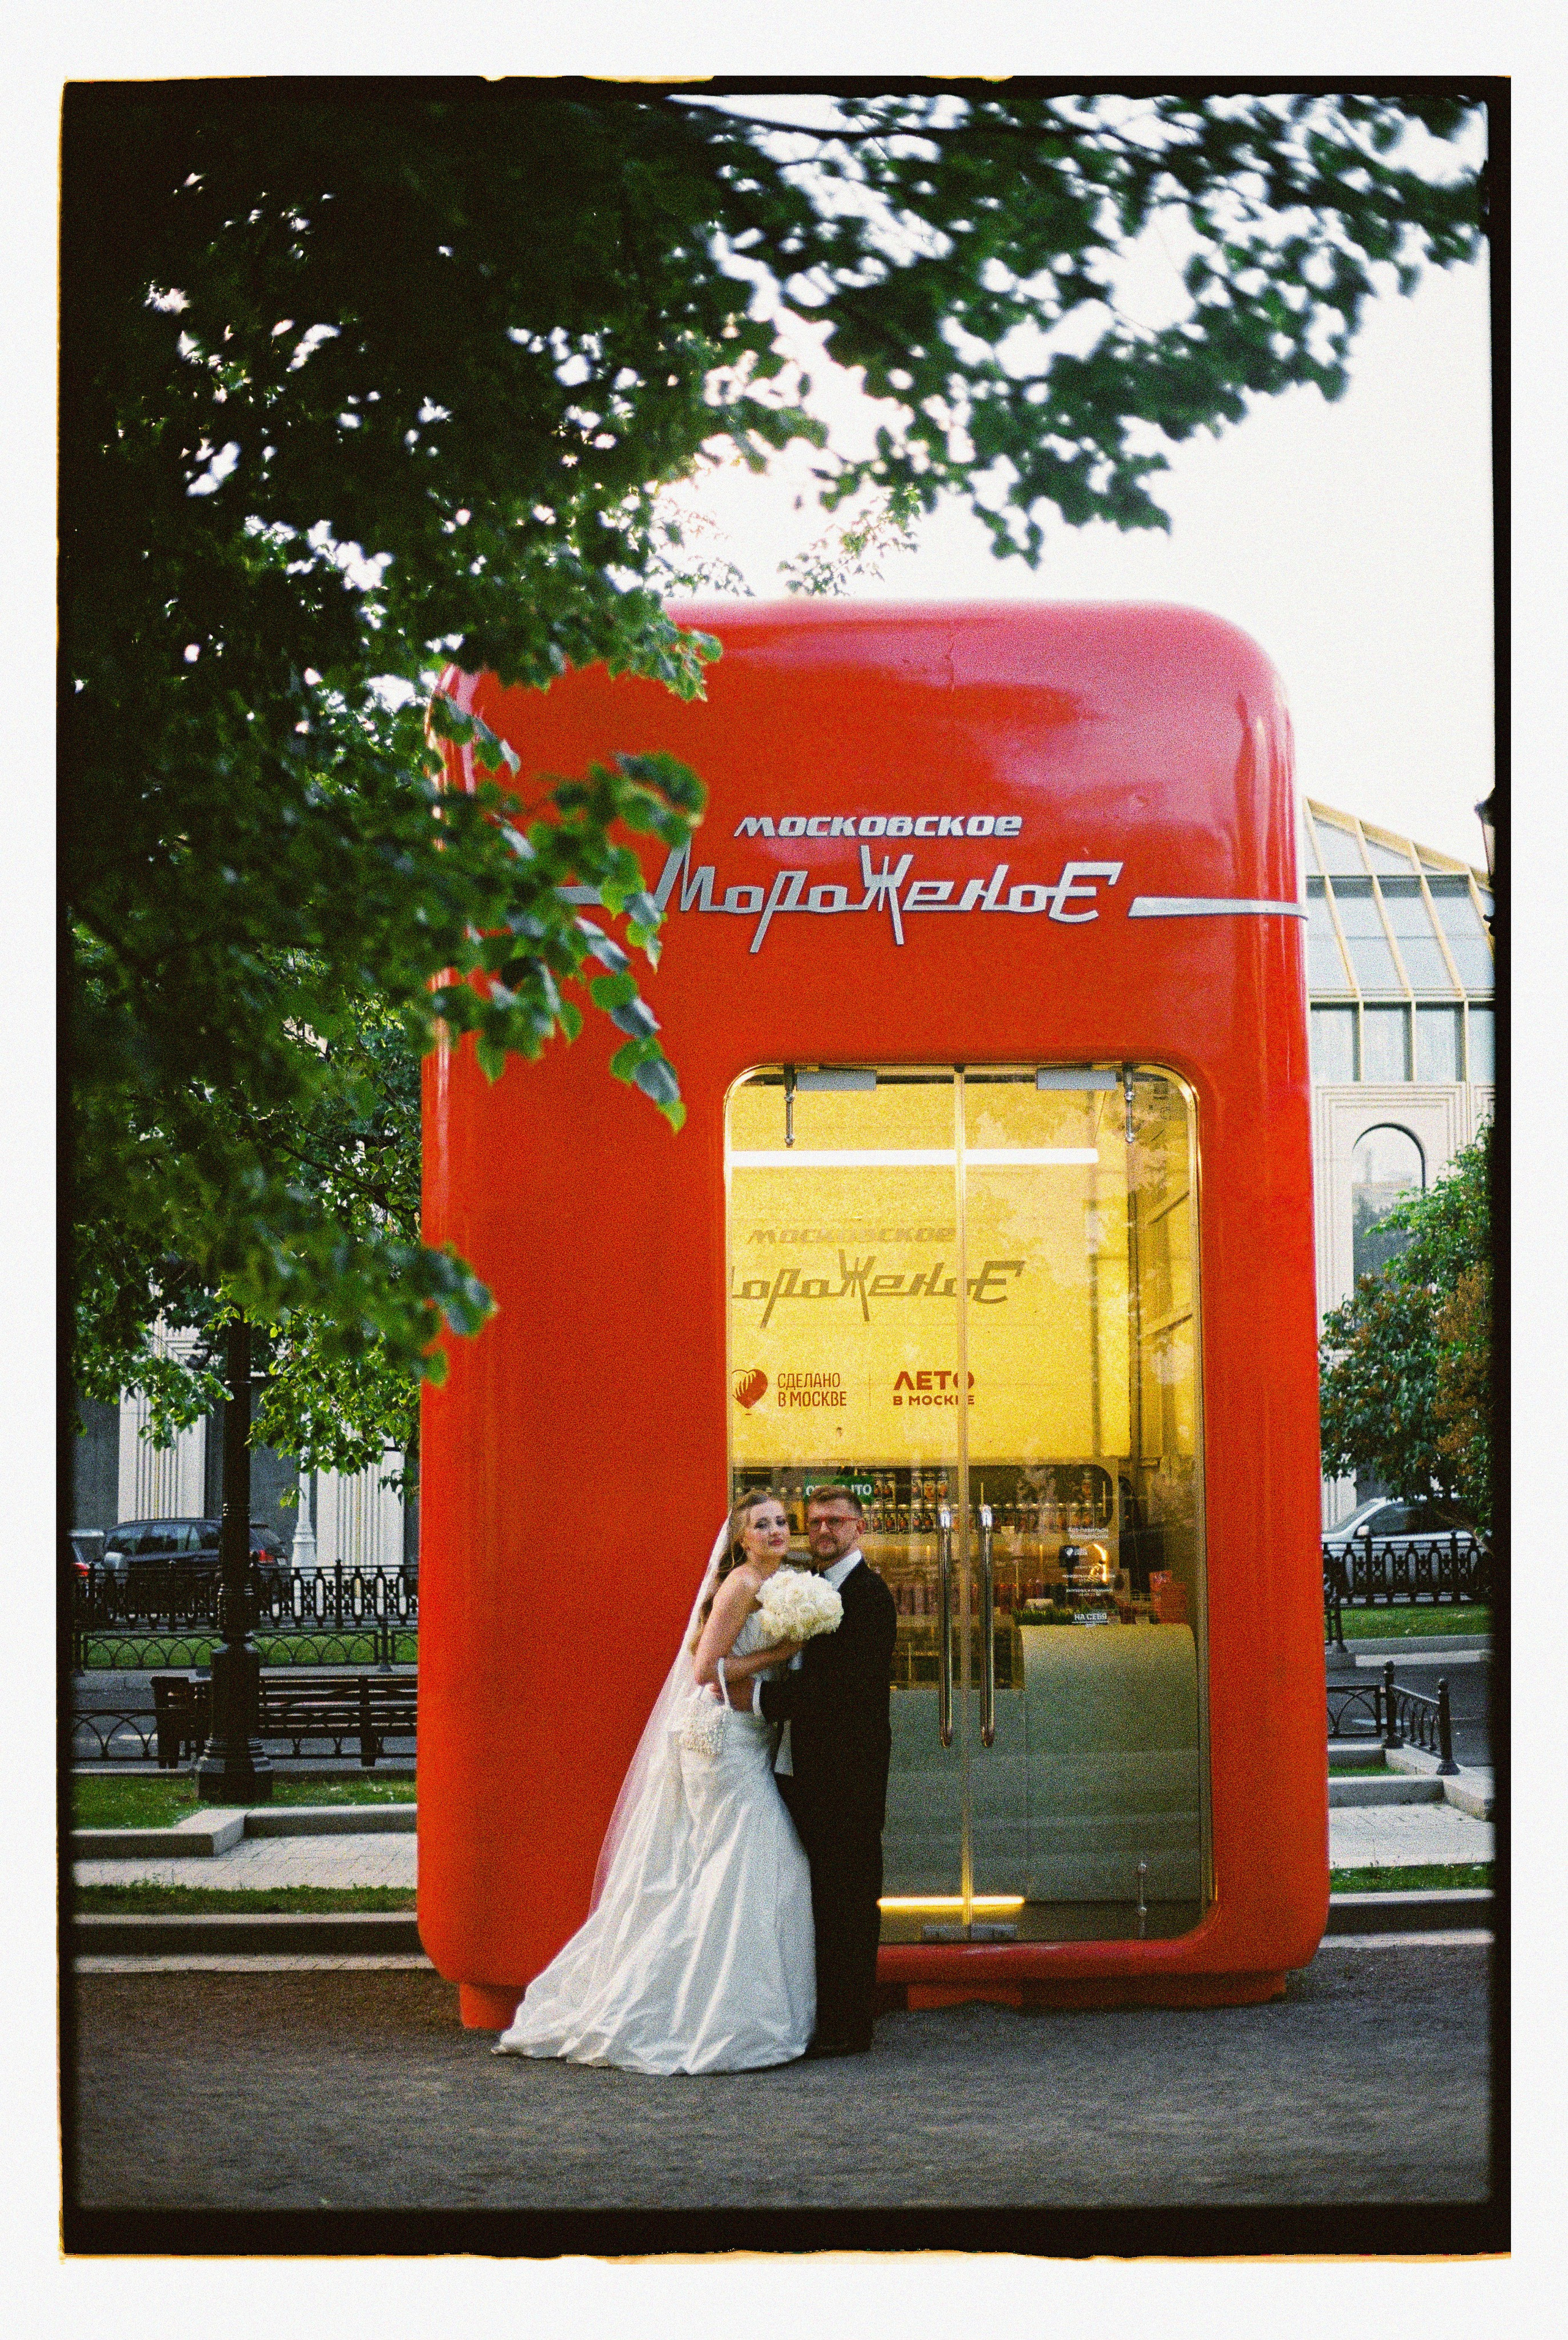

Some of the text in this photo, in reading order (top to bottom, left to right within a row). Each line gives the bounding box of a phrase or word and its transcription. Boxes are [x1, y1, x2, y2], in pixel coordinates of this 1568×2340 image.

[778, 1373, 840, 1390] СДЕЛАНО
[893, 1371, 974, 1390] ЛЕТО
[778, 1391, 846, 1406] В МОСКВЕ
[893, 1395, 902, 1405] В
